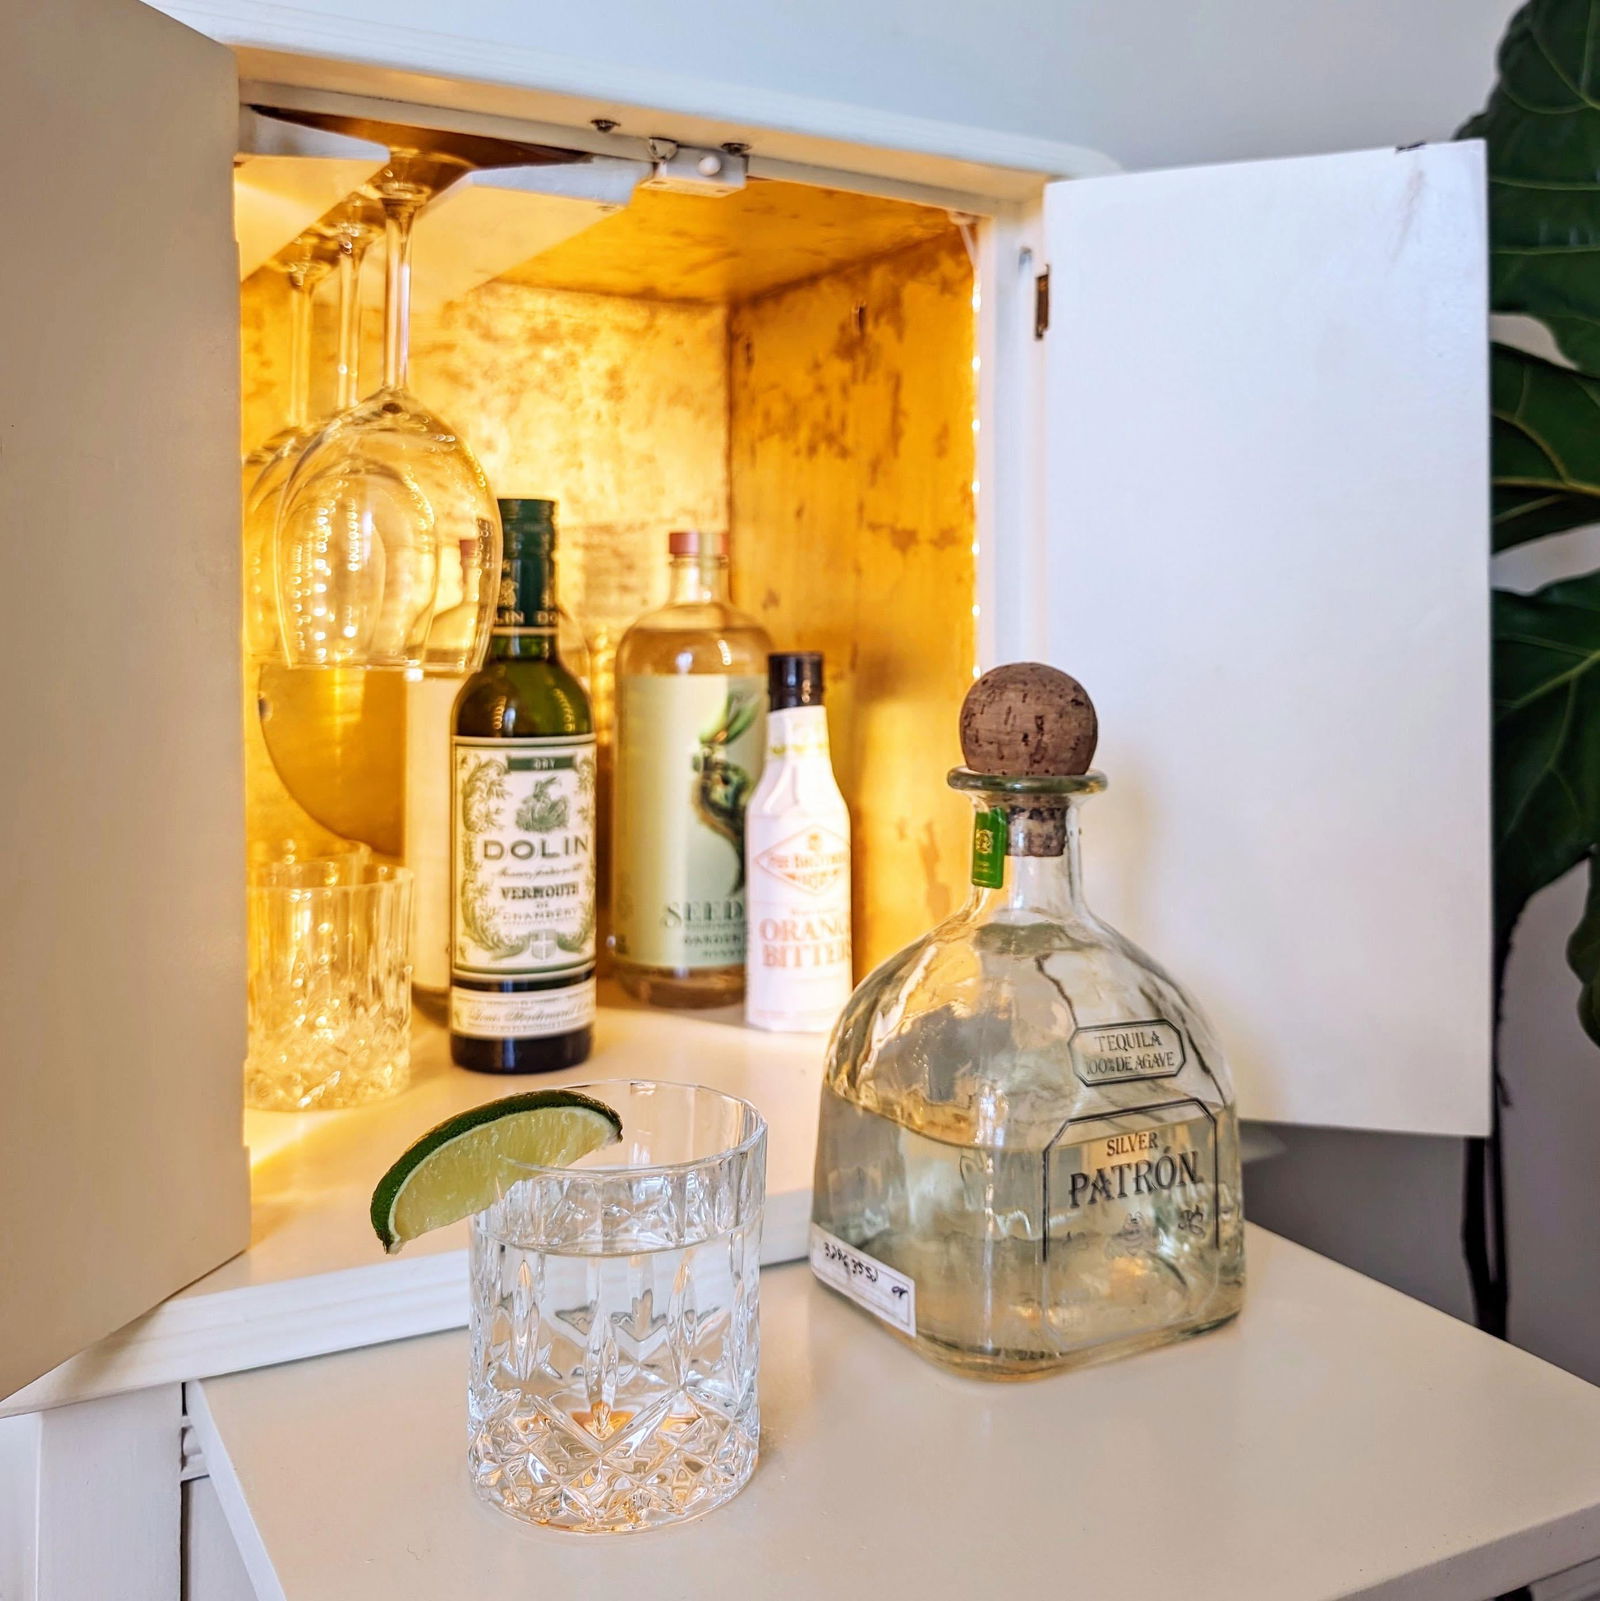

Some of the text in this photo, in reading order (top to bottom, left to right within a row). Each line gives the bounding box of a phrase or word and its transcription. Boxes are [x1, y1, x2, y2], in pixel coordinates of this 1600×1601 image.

[534, 757, 556, 770] DRY
[484, 835, 589, 861] DOLIN
[501, 884, 578, 900] VERMOUTH
[1094, 1030, 1163, 1053] TEQUILA
[1134, 1050, 1176, 1071] AGAVE
[1106, 1131, 1159, 1157] SILVER
[1069, 1148, 1202, 1208] PATRÓN
